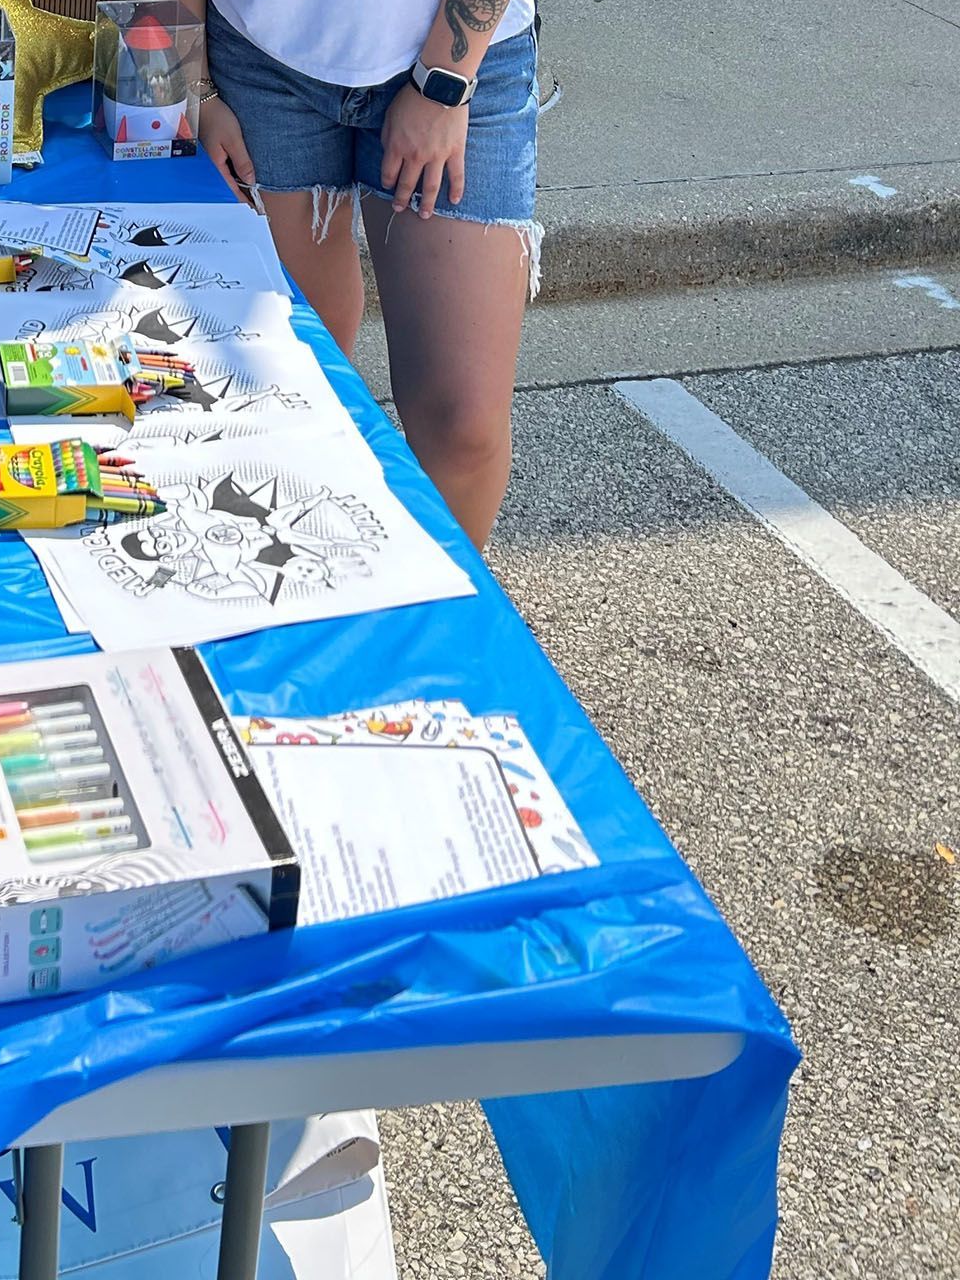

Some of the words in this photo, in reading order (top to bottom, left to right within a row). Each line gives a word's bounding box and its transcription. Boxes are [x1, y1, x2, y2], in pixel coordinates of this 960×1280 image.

[0, 103, 10, 162] PROJECTOR
[115, 145, 169, 154] CONSTELLATION
[30, 448, 46, 490] Crayola
[211, 717, 249, 778] ZEBRA
